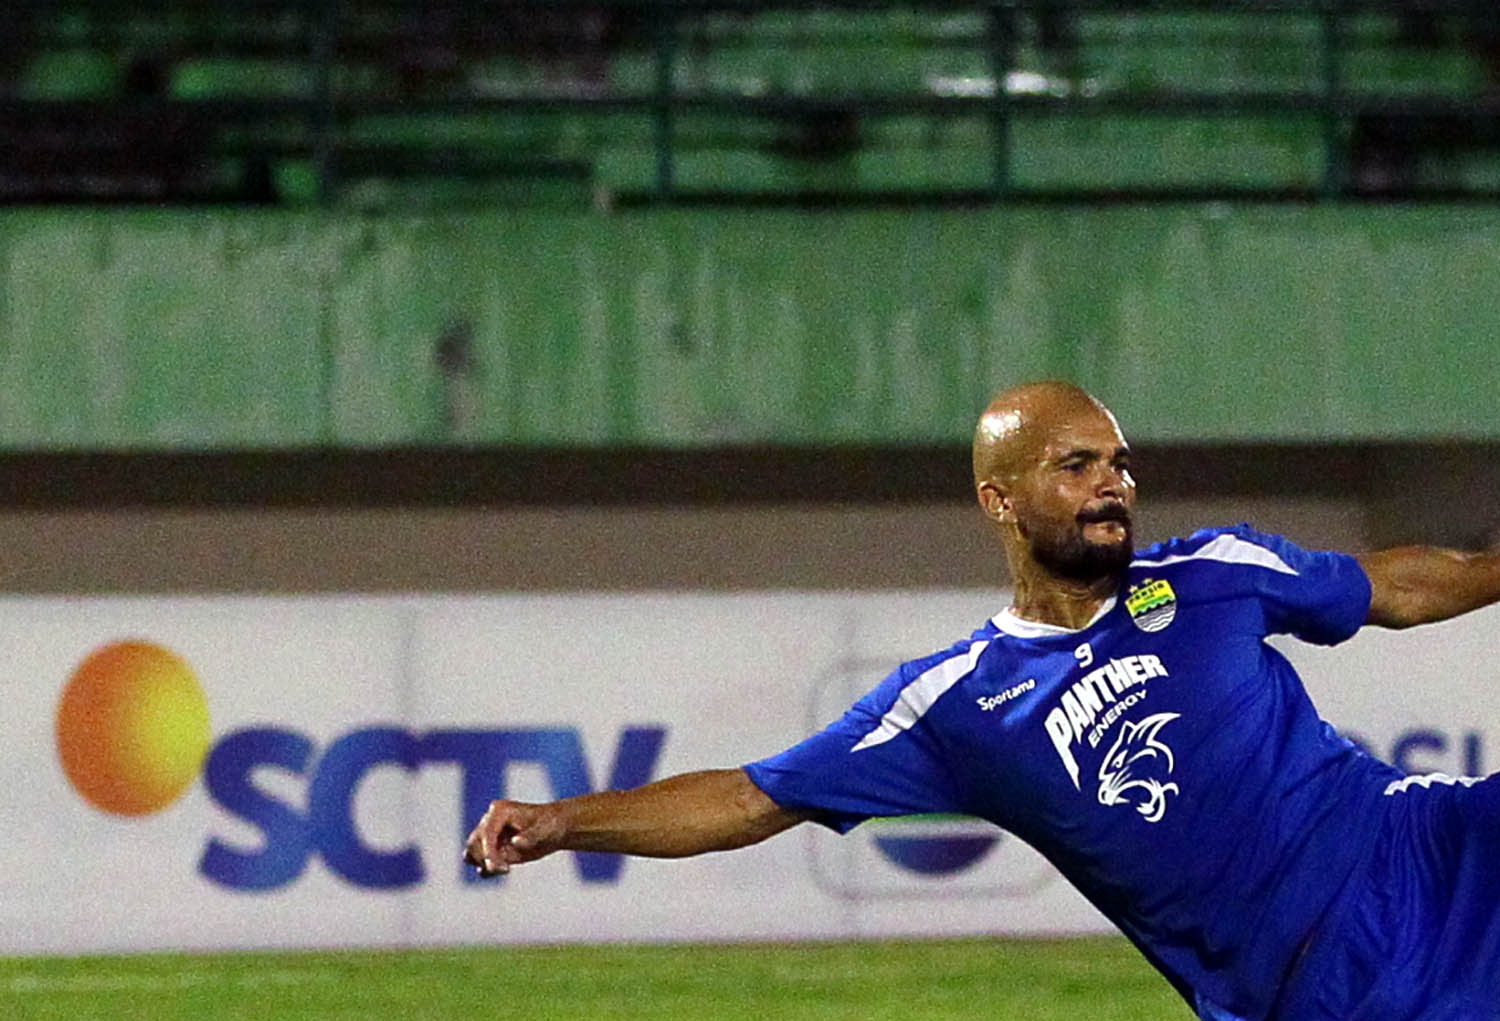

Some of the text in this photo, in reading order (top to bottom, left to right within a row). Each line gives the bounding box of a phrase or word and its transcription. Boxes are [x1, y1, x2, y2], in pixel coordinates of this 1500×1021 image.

[1074, 642, 1094, 668] 9
[976, 679, 1035, 711] Sportama
[1044, 654, 1169, 792] PANTHER
[1088, 689, 1147, 749] ENERGY
[198, 724, 666, 894] SCTV
